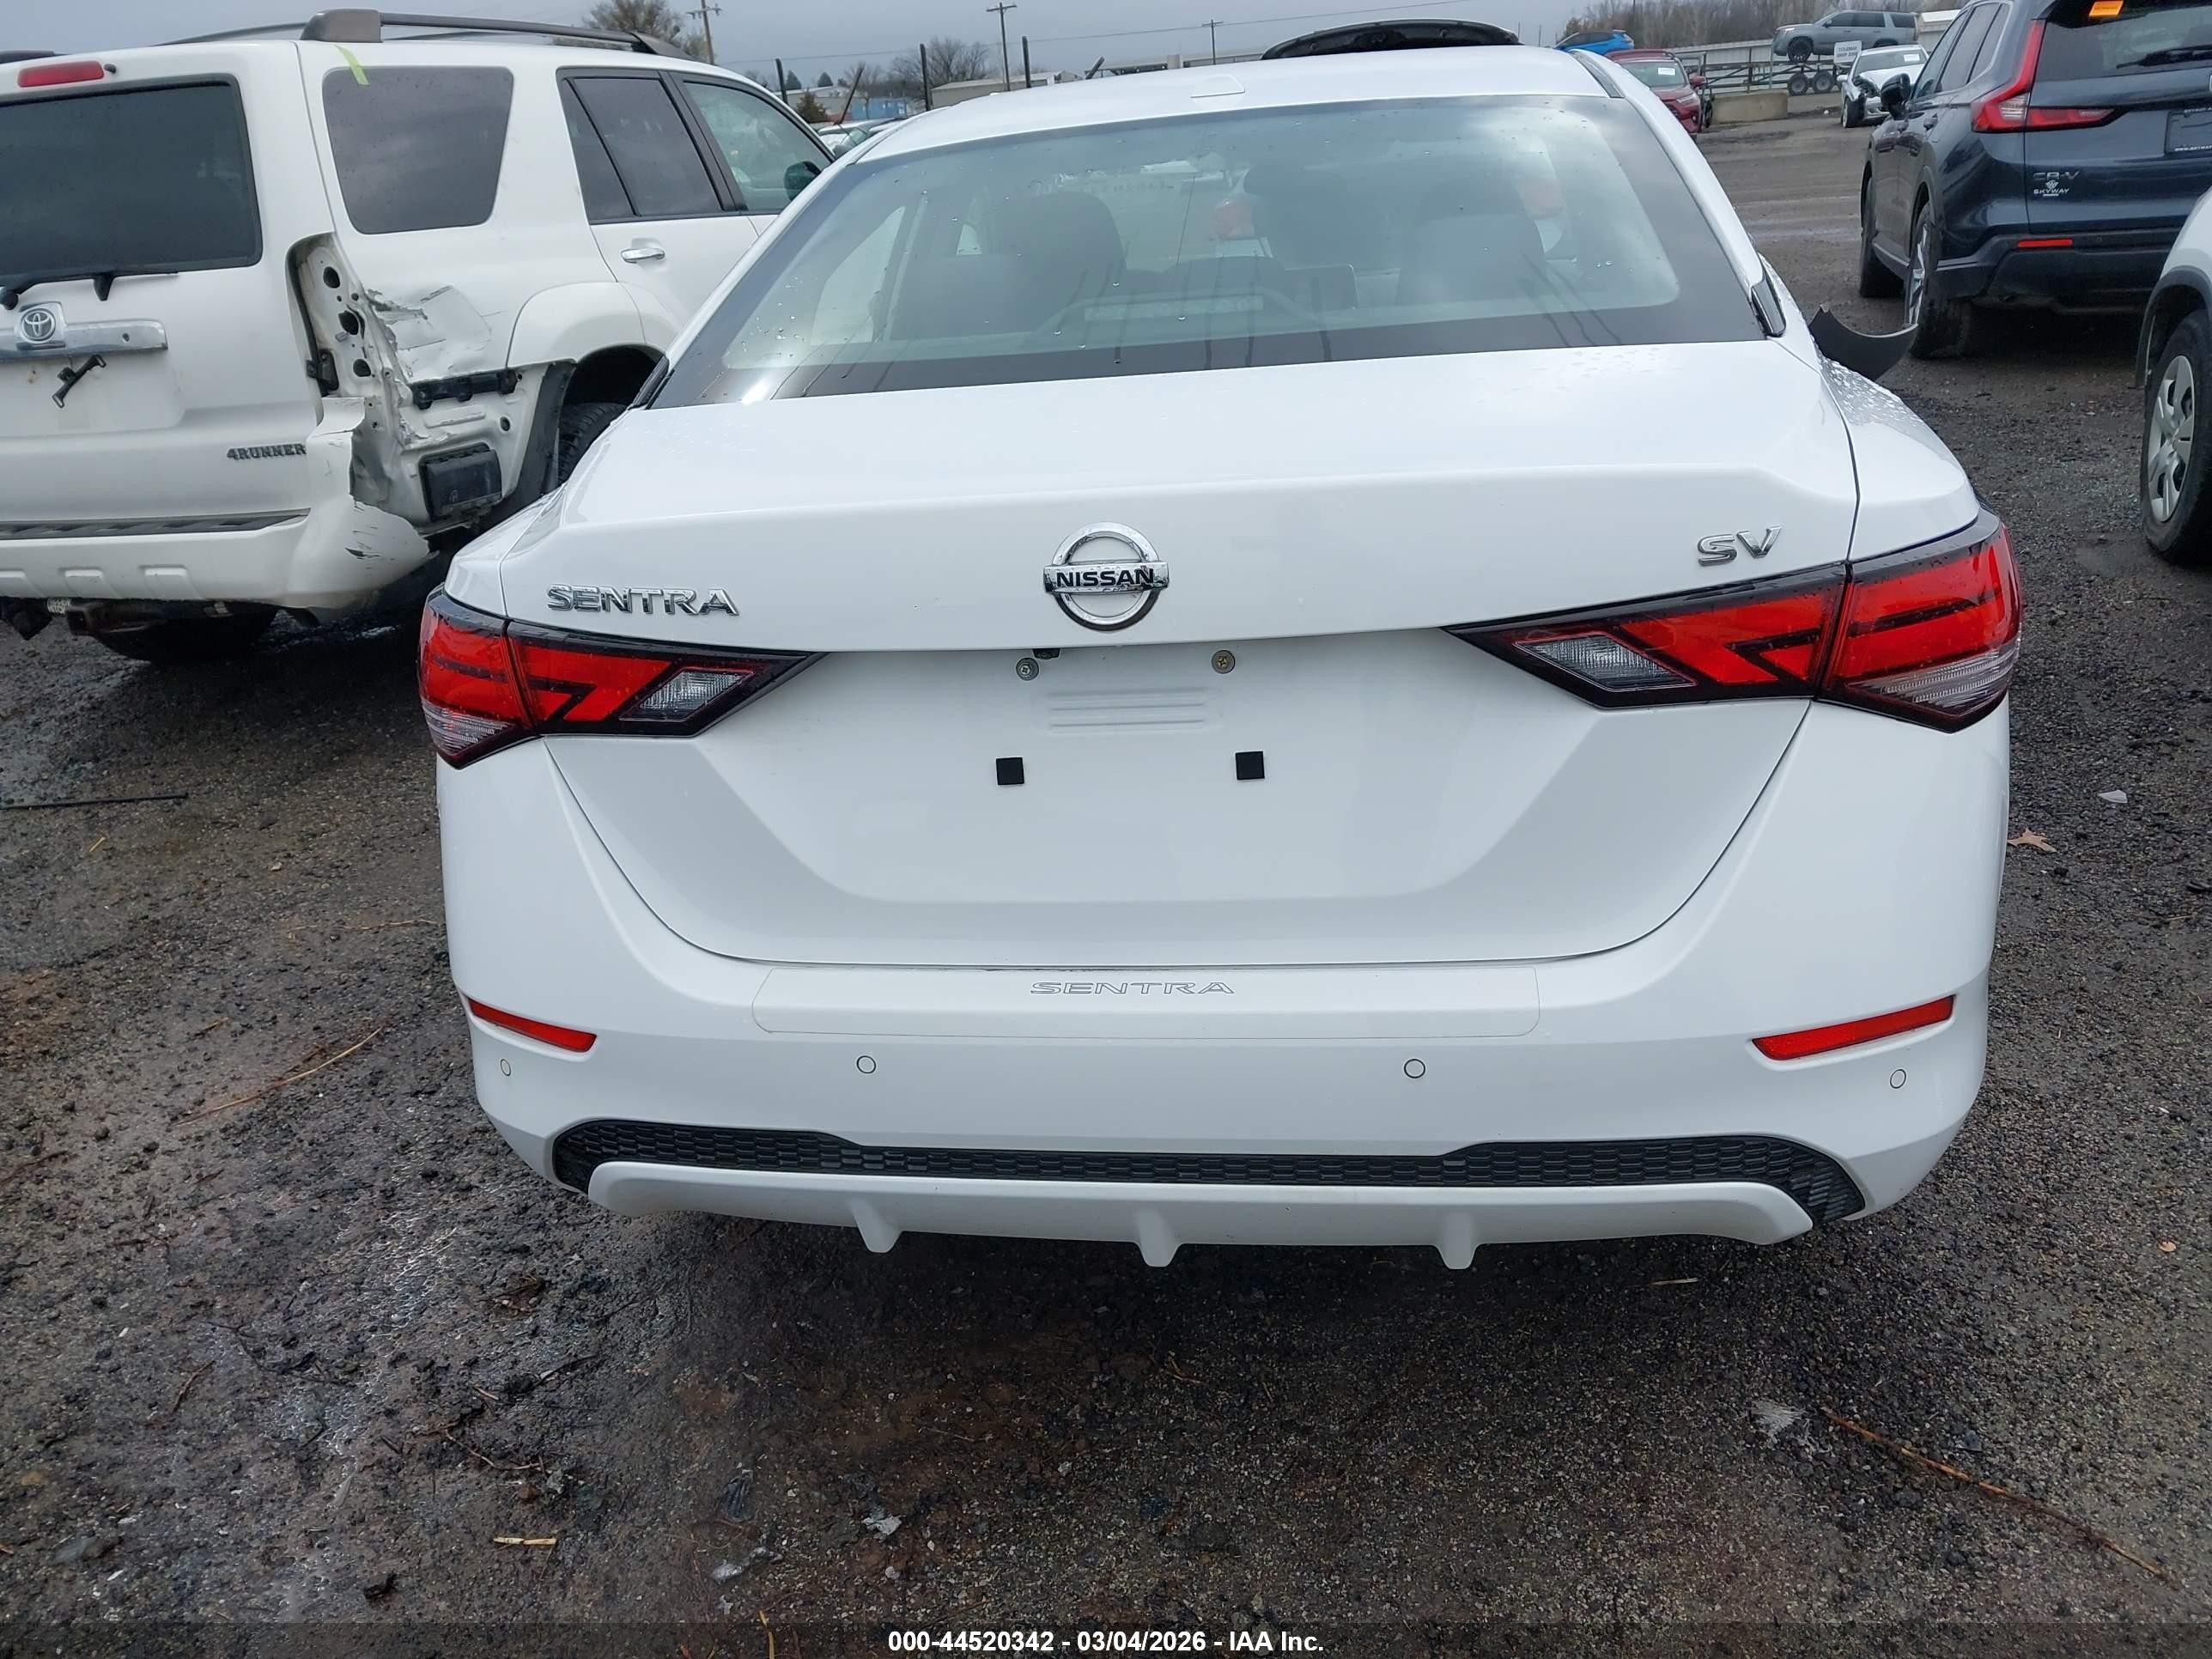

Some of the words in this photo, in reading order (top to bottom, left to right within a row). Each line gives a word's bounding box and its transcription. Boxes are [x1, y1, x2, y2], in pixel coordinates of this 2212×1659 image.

[2033, 171, 2080, 180] CR-V
[226, 442, 307, 460] 4RUNNER
[1698, 526, 1782, 567] SV
[1056, 568, 1154, 587] NISSAN
[546, 584, 739, 616] SENTRA
[1030, 981, 1234, 994] SENTRA
